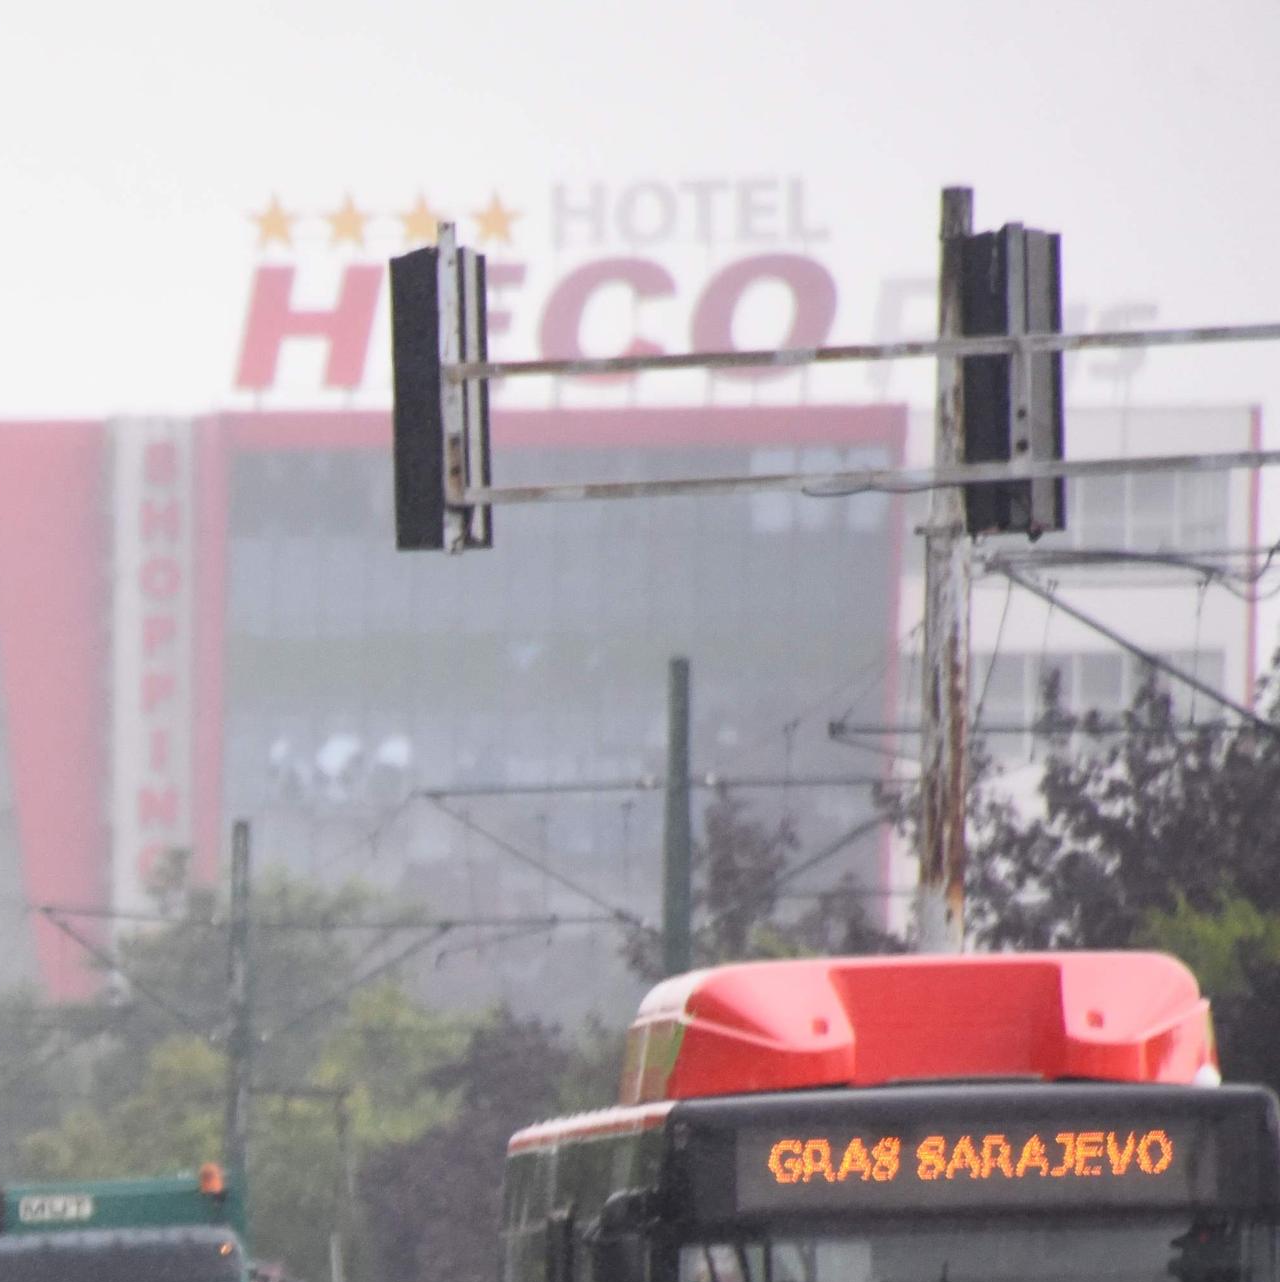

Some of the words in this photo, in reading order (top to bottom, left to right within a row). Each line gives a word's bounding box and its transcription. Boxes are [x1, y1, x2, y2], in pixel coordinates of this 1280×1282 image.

[550, 178, 832, 247] HOTEL
[768, 1137, 901, 1183] GRAS
[916, 1129, 1173, 1180] SARAJEVO
